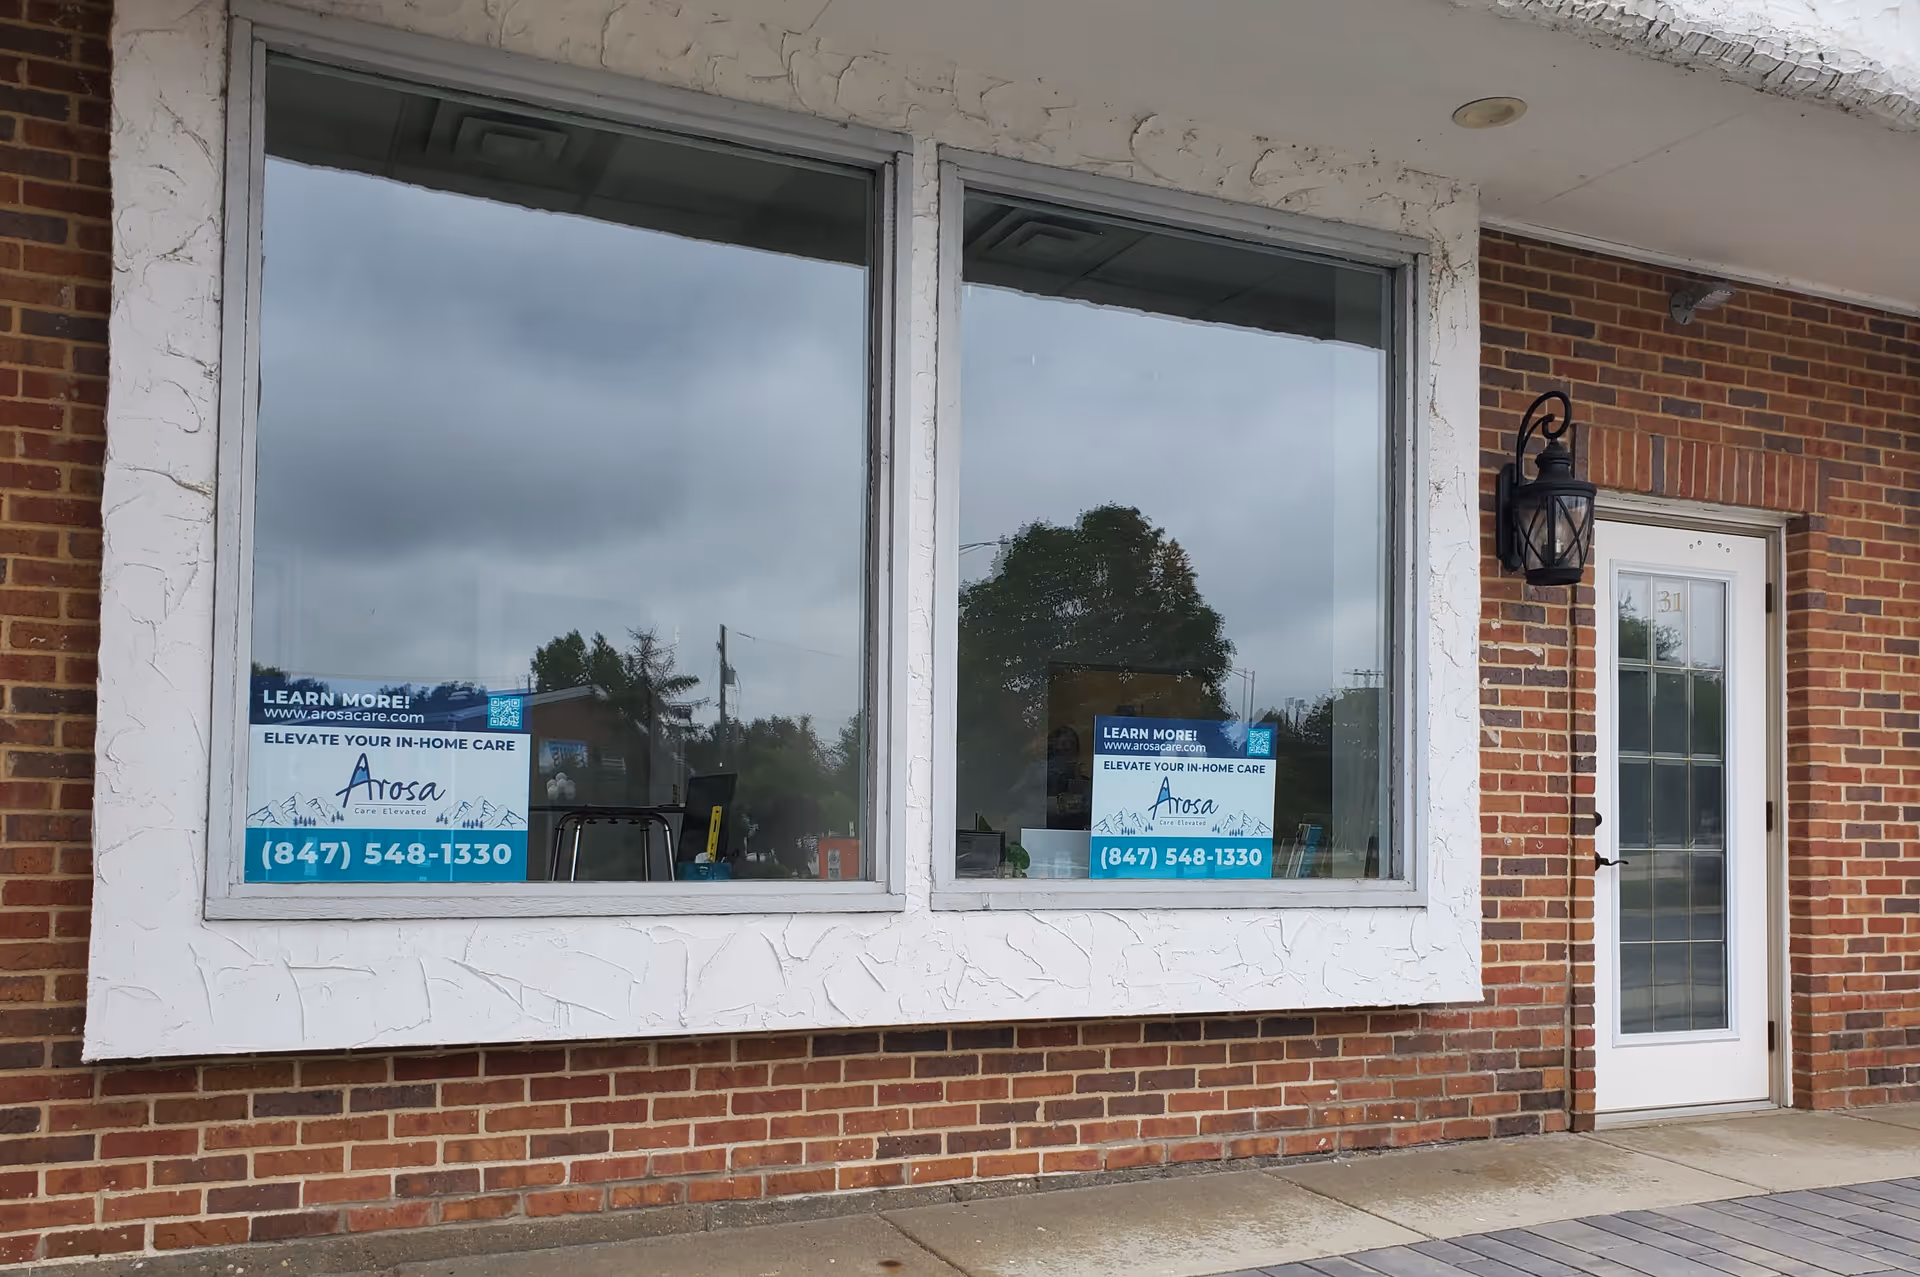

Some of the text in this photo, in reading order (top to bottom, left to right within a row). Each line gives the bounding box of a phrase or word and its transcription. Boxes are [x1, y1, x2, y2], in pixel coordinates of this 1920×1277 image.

[1658, 591, 1682, 612] 31
[263, 689, 410, 709] LEARN MORE!
[264, 707, 425, 724] www.arosacare.com
[264, 732, 516, 751] ELEVATE YOUR IN-HOME CARE
[1104, 727, 1197, 741] LEARN MORE!
[1104, 742, 1206, 753] www.arosacare.com
[1104, 761, 1266, 774] ELEVATE YOUR IN-HOME CARE
[335, 752, 446, 808] Arosa
[1148, 776, 1219, 821] Arosa
[354, 807, 377, 815] Care
[261, 841, 512, 870] (847) 548-1330
[1101, 847, 1262, 869] (847) 548-1330
